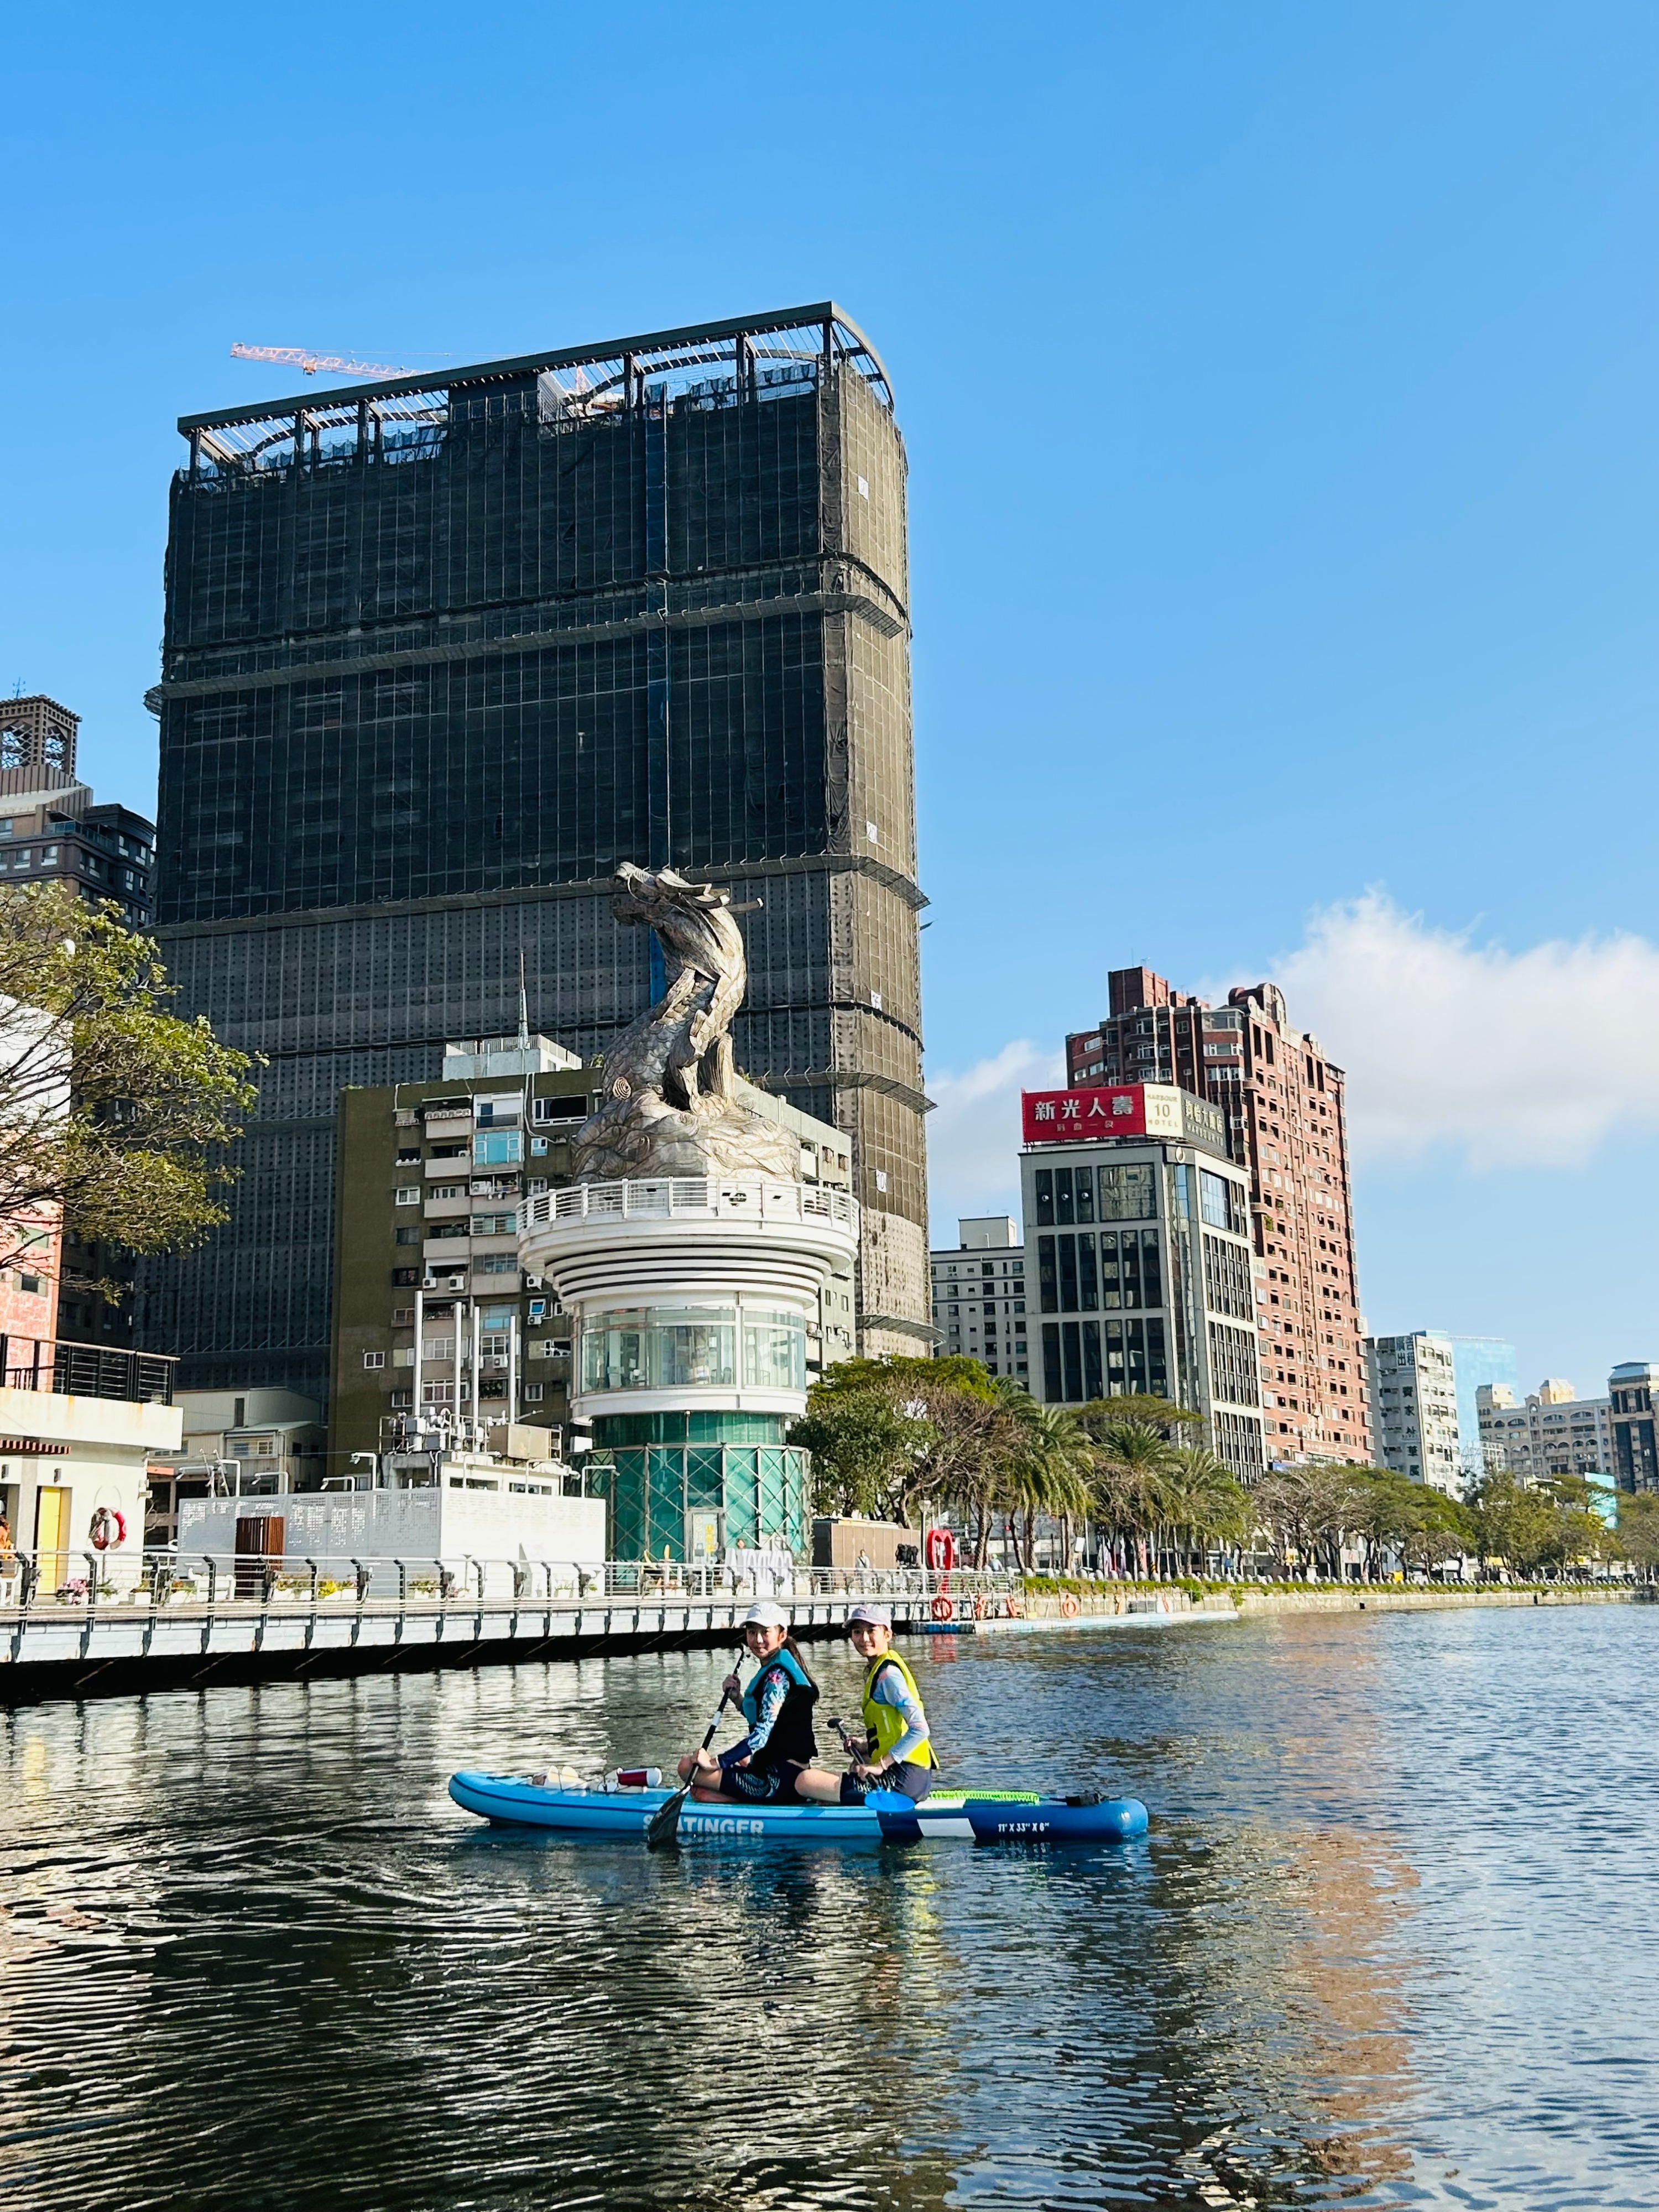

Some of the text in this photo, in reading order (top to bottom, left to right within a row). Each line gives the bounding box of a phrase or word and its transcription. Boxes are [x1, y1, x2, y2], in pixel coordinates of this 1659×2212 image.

[1147, 1094, 1177, 1102] HARBOUR
[1035, 1095, 1133, 1120] 新光人壽
[1155, 1104, 1170, 1117] 10
[643, 1814, 764, 1834] SATINGER
